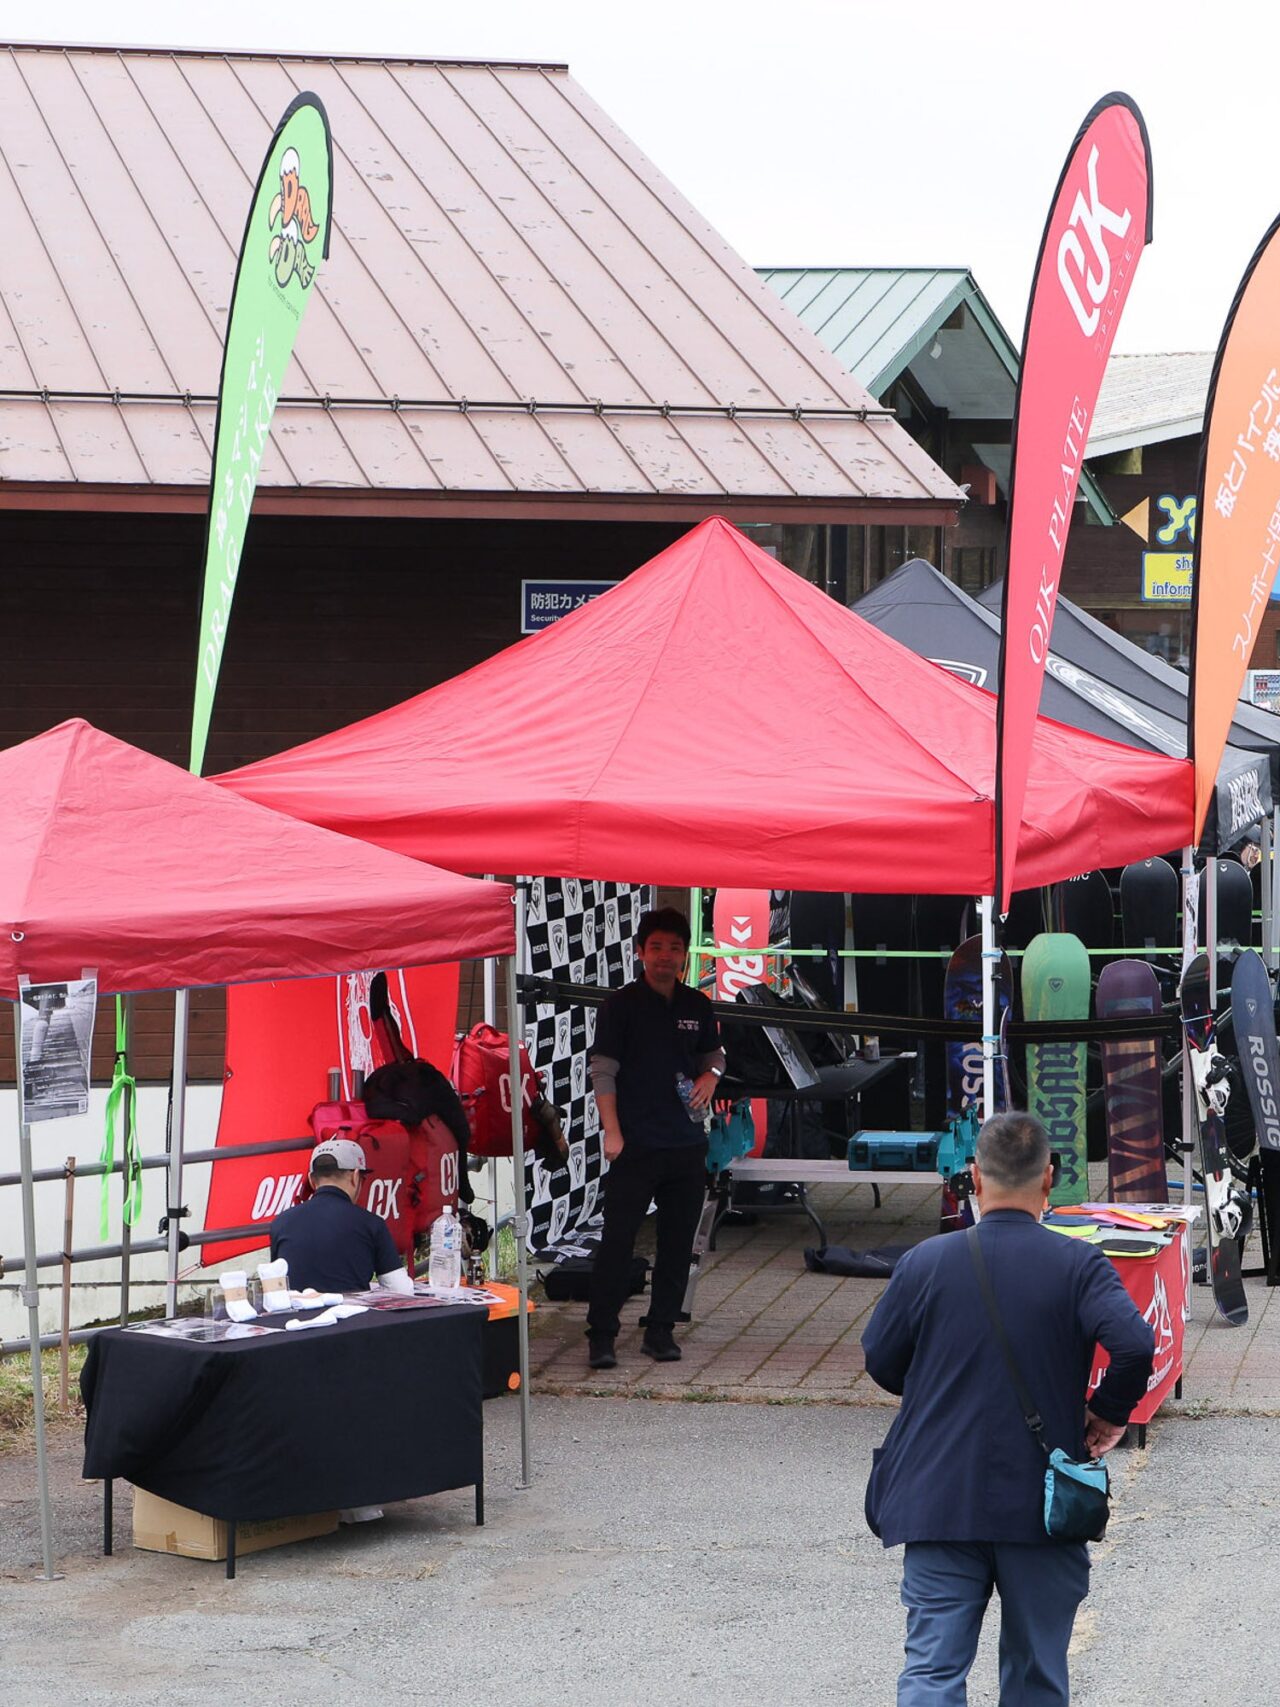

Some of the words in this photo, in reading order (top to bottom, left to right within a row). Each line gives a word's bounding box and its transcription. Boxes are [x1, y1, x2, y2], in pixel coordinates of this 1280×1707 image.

[1048, 395, 1088, 554] PLATE
[1175, 556, 1194, 570] sh
[1152, 582, 1193, 595] inform
